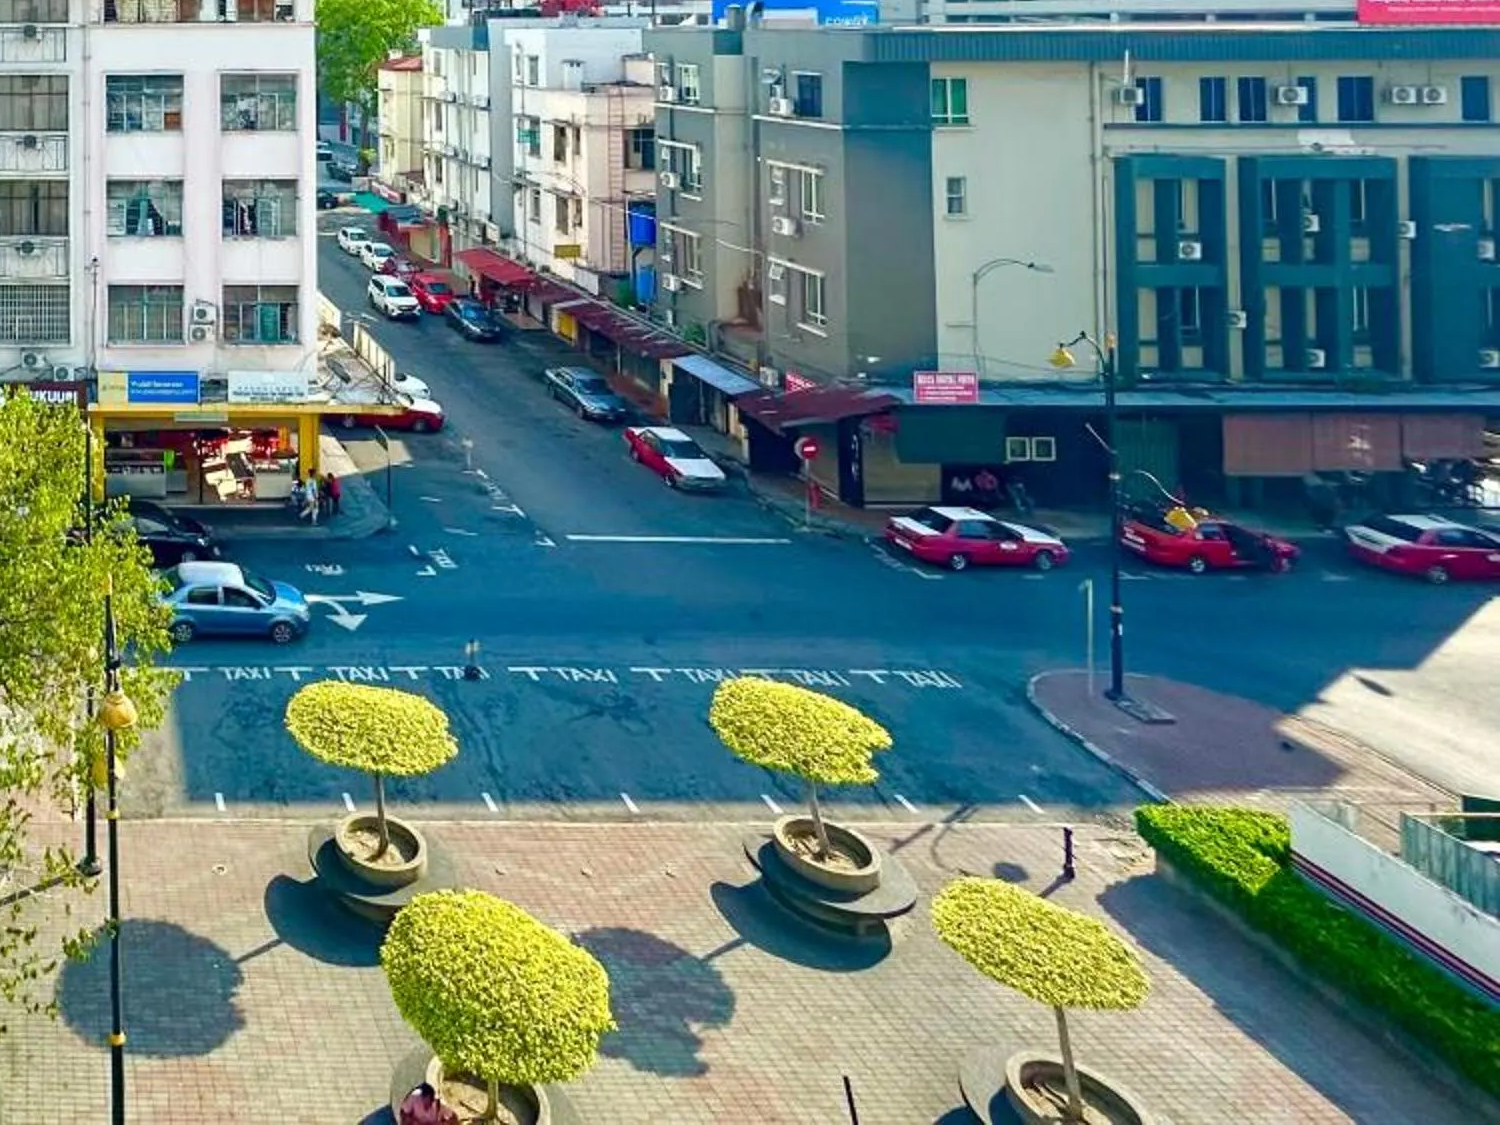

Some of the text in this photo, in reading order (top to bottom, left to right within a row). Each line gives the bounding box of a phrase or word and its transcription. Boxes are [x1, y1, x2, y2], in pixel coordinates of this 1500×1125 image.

[218, 666, 270, 680] TAXI
[327, 666, 389, 682] TAXI
[433, 666, 491, 680] TAI
[550, 667, 618, 684] TAXI
[789, 669, 851, 686] TAXI
[896, 670, 962, 688] TAXI
